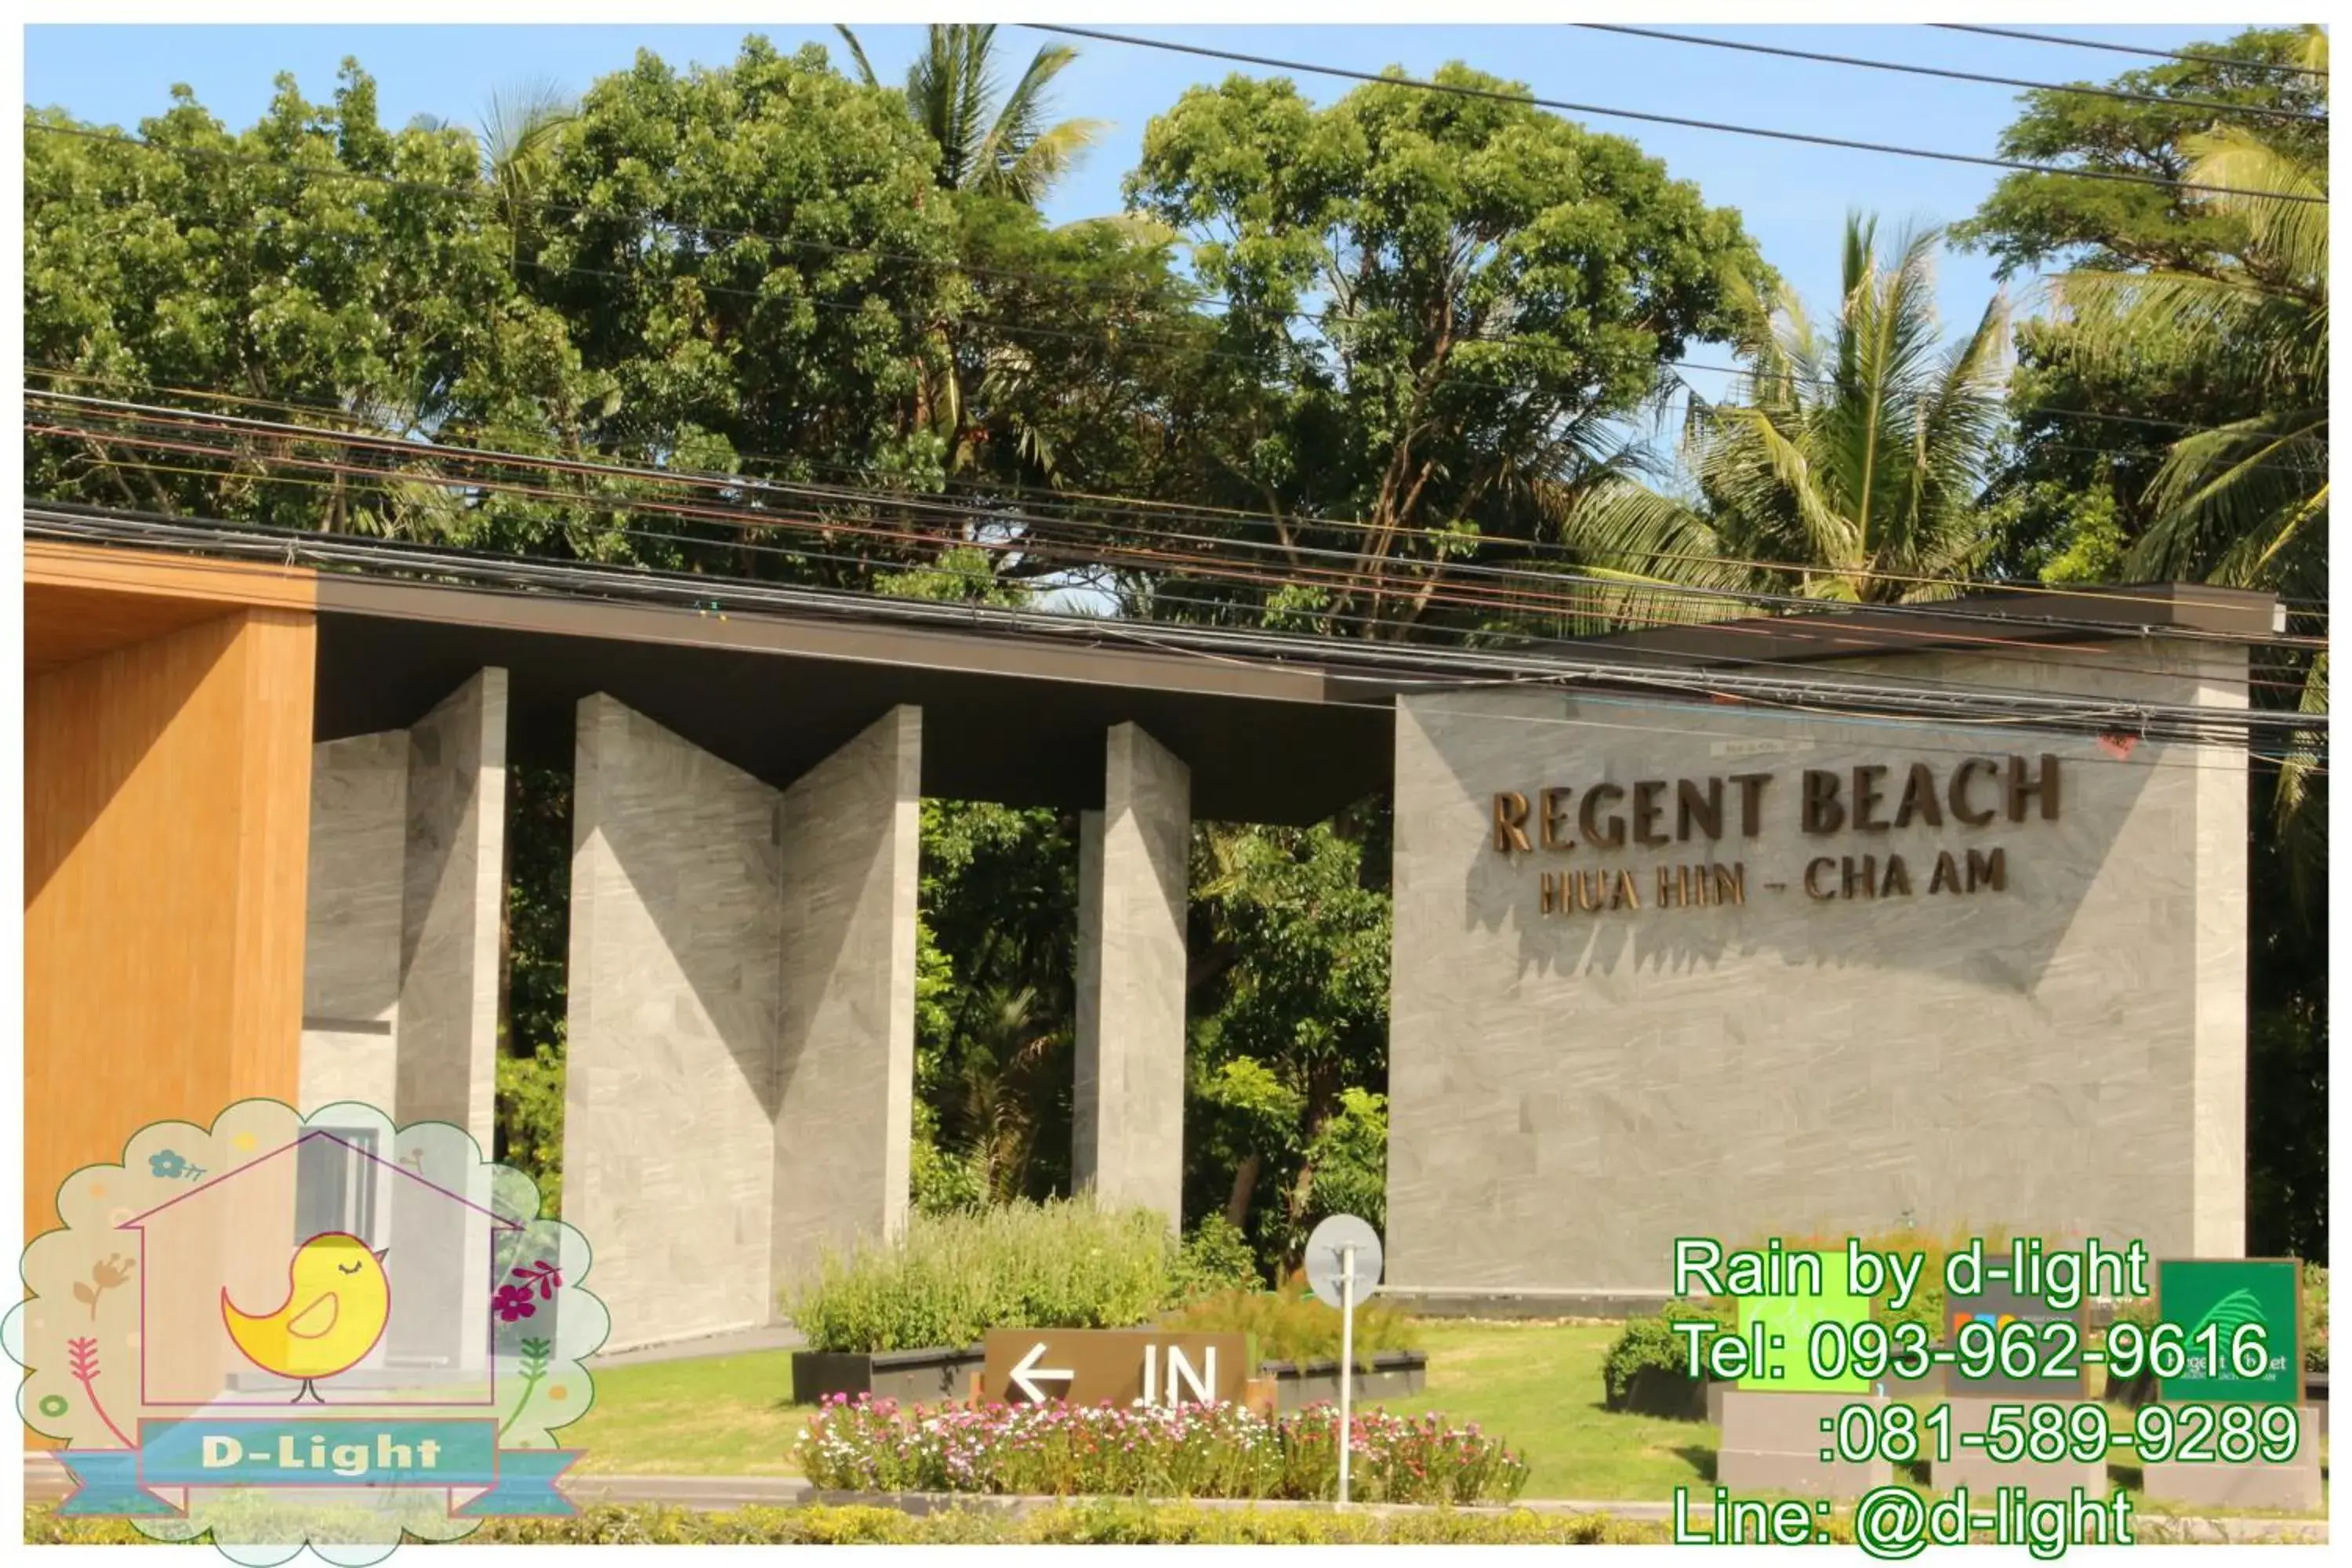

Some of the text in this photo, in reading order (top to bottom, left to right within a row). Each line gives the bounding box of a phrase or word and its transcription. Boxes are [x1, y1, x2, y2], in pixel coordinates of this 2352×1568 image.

[1492, 753, 2060, 853] REGENT BEACH
[1539, 868, 1640, 915] HUA
[1656, 862, 1746, 908] HIN
[1805, 853, 1912, 901] CHA
[1929, 848, 2007, 895] AM
[1145, 1345, 1216, 1409] IN
